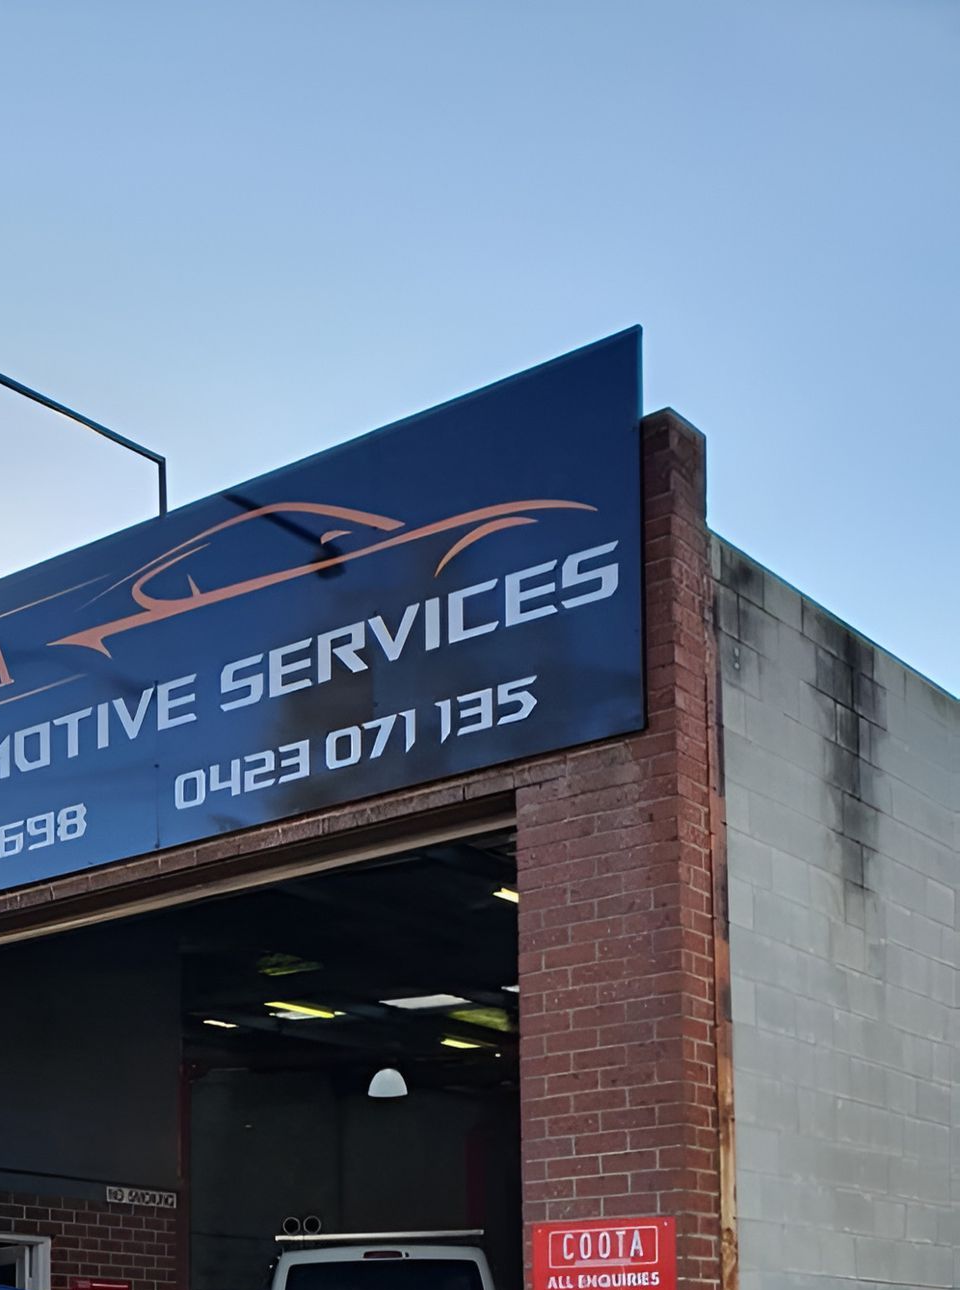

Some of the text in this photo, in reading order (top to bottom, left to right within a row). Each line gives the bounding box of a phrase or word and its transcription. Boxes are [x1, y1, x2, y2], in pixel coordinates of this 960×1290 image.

[220, 540, 619, 712] SERVICES
[175, 675, 538, 810] 0423 071 135
[548, 1272, 660, 1290] ALL ENQUIRIES
[563, 1230, 644, 1260] COOTA
